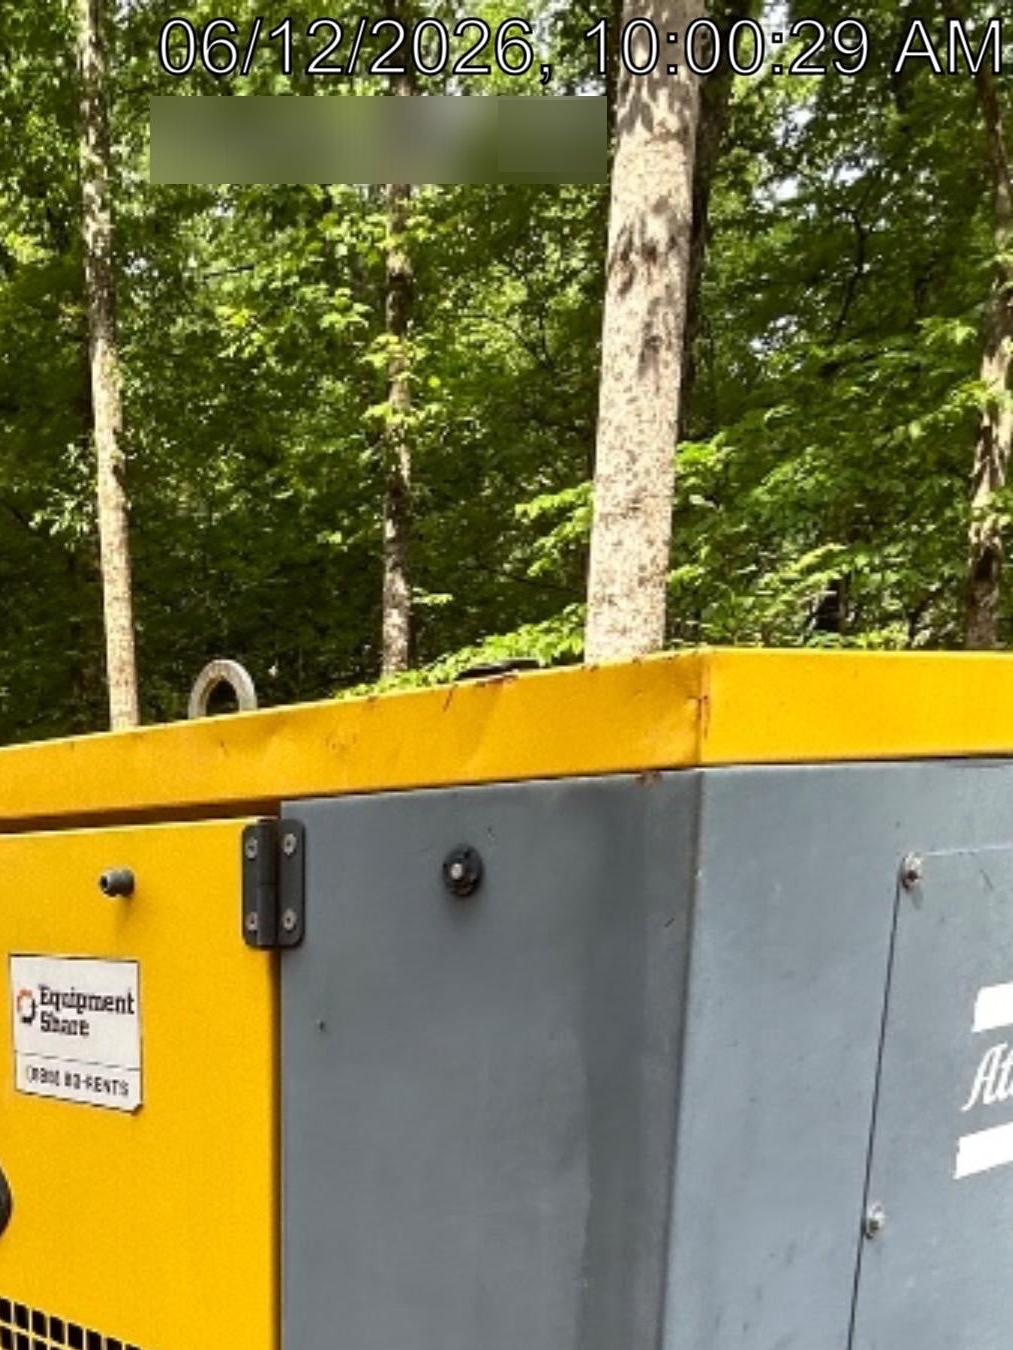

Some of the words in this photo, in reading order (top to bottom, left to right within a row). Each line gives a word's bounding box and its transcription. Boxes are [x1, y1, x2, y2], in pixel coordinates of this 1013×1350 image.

[38, 984, 134, 1015] Equipment
[40, 1010, 90, 1036] Share
[960, 1040, 1013, 1113] At
